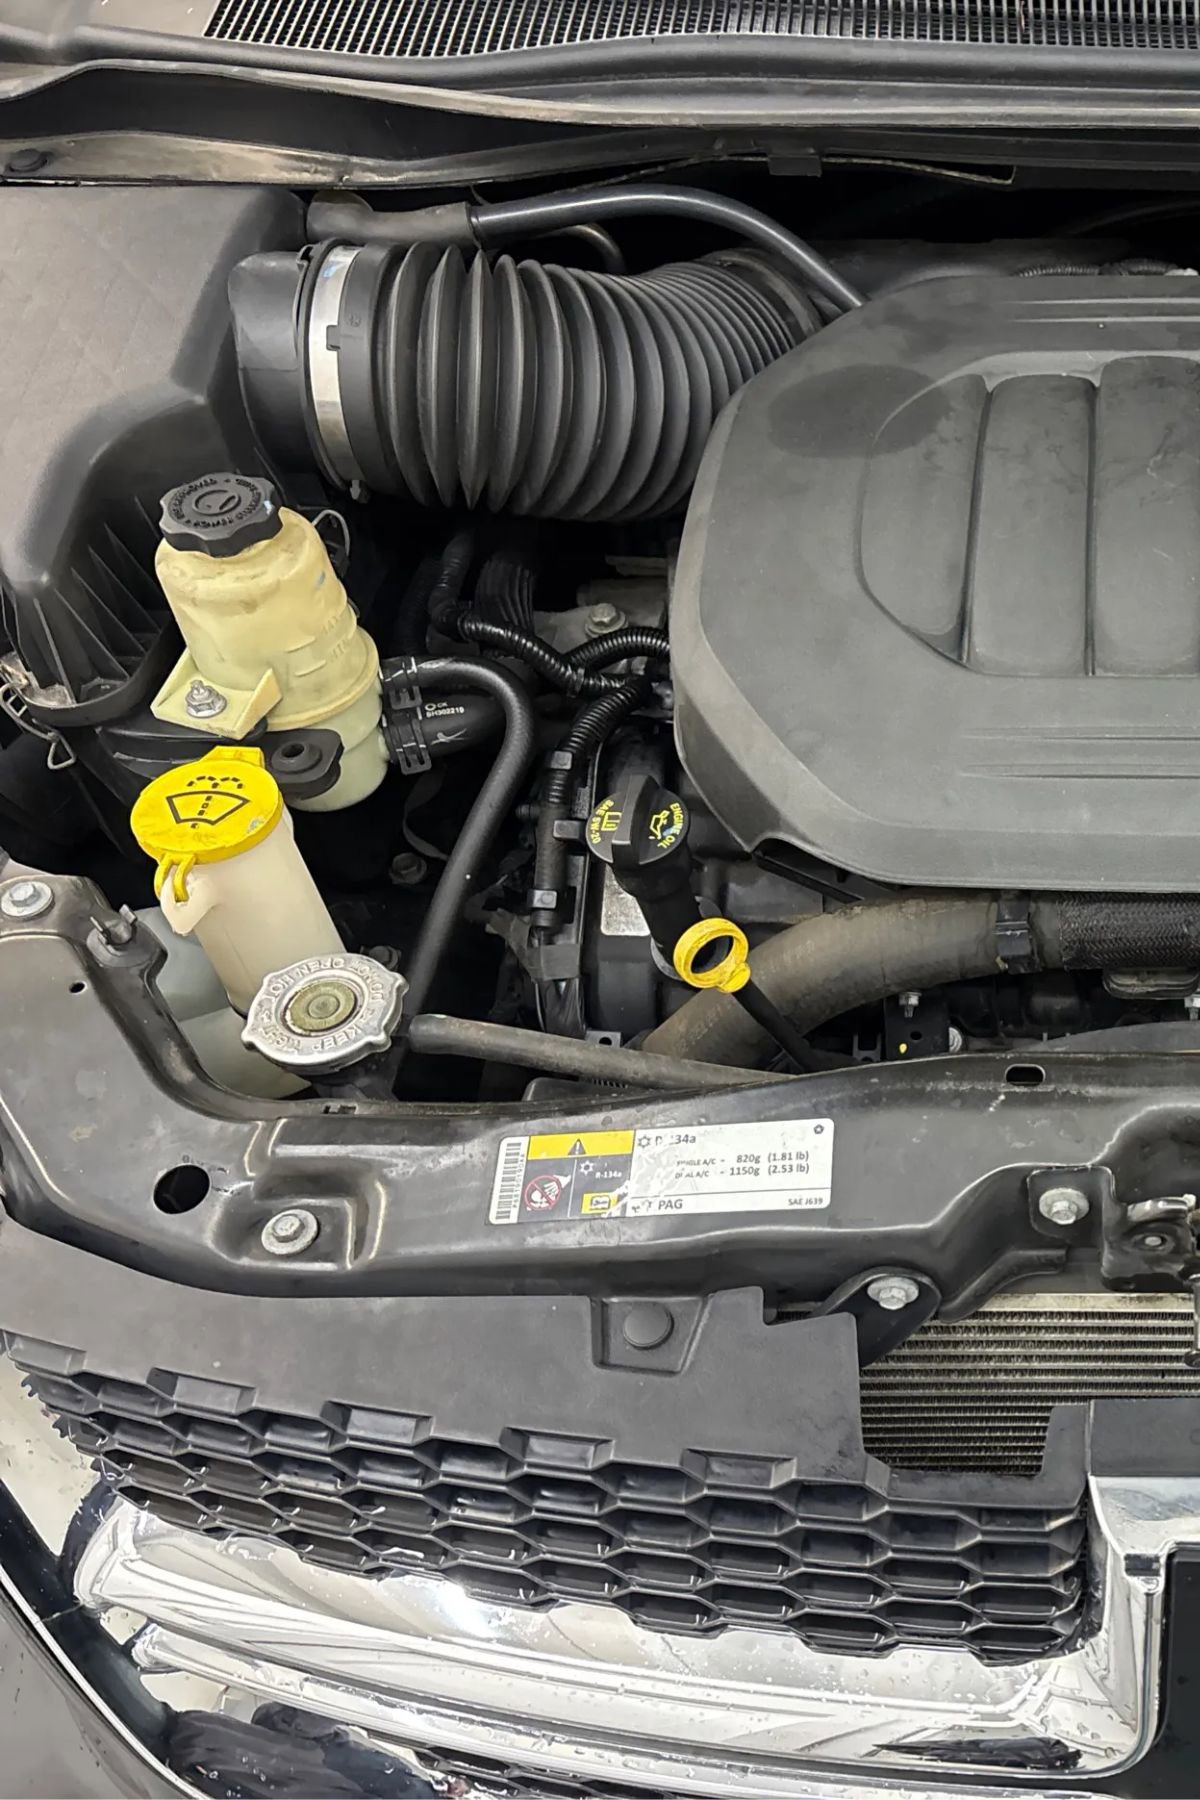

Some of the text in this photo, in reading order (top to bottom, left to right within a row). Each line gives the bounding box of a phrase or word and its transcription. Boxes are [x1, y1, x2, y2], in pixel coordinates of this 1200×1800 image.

[595, 799, 614, 817] SAE
[657, 802, 683, 849] ENGINE OIL
[295, 957, 345, 978] OPEN
[263, 974, 295, 1001] HOT
[311, 1023, 362, 1053] KEEP
[703, 1157, 716, 1166] A/C
[736, 1153, 761, 1166] 820g
[768, 1151, 793, 1164] (1.81
[795, 1150, 810, 1163] lb)
[696, 1170, 710, 1178] A/C
[729, 1165, 761, 1178] 1150g
[768, 1164, 793, 1176] (2.53
[795, 1162, 810, 1174] lb)
[658, 1198, 683, 1211] PAG
[787, 1196, 823, 1206] SAE J639
